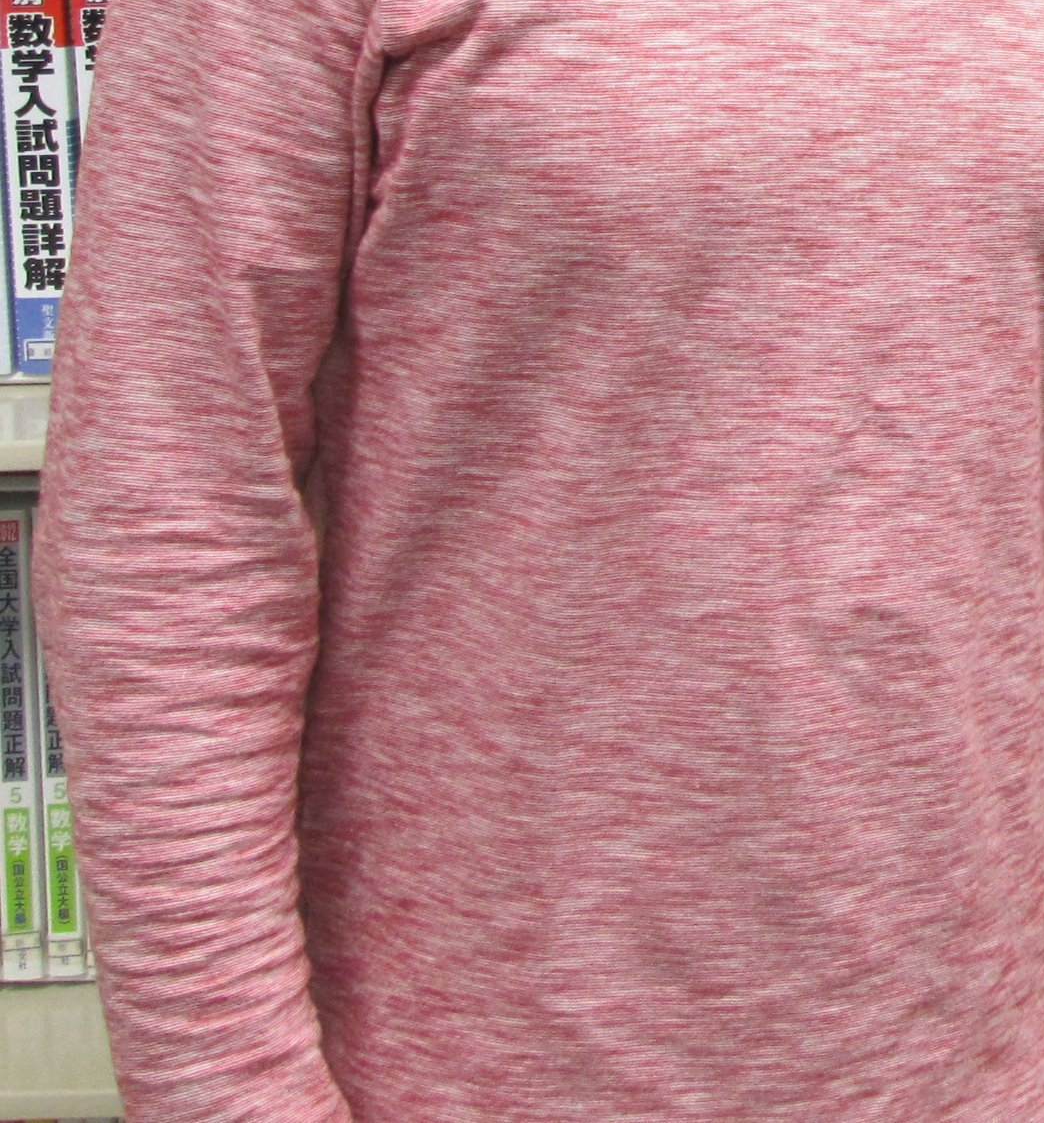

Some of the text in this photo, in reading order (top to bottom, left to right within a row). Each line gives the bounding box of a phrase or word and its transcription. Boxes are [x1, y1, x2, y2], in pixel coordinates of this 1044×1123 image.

[8, 14, 67, 292] 数学入試問題詳解
[10, 787, 22, 804] 5
[53, 782, 66, 799] 5
